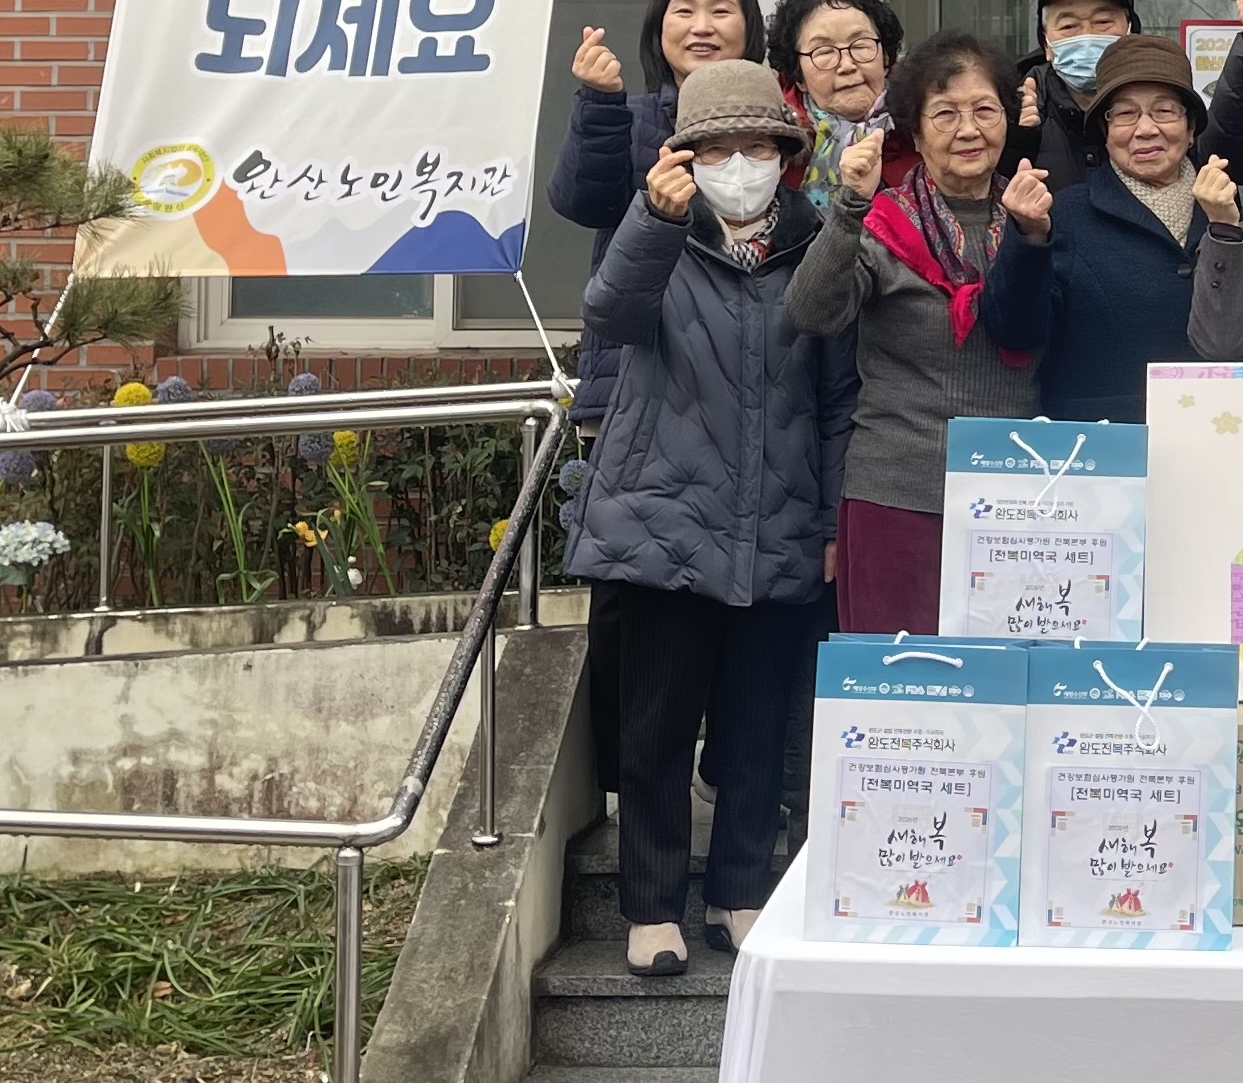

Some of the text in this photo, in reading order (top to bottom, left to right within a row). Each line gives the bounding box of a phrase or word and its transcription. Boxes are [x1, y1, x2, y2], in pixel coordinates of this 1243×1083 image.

[233, 149, 511, 220] 완산노인복지관
[989, 550, 1094, 565] [전복미역국 세트]
[1016, 579, 1072, 616] 새해 복
[1007, 616, 1081, 633] 많이 받으세요
[868, 737, 955, 752] 완도전복주식회사
[861, 777, 971, 796] [전복미역국 세트]
[1071, 787, 1181, 804] [전복미역국 세트]
[887, 812, 947, 851] 새해 복
[1099, 819, 1157, 858] 새해 복
[879, 848, 956, 869] 많이 받으세요
[1090, 858, 1168, 878] 많이 받으세요
